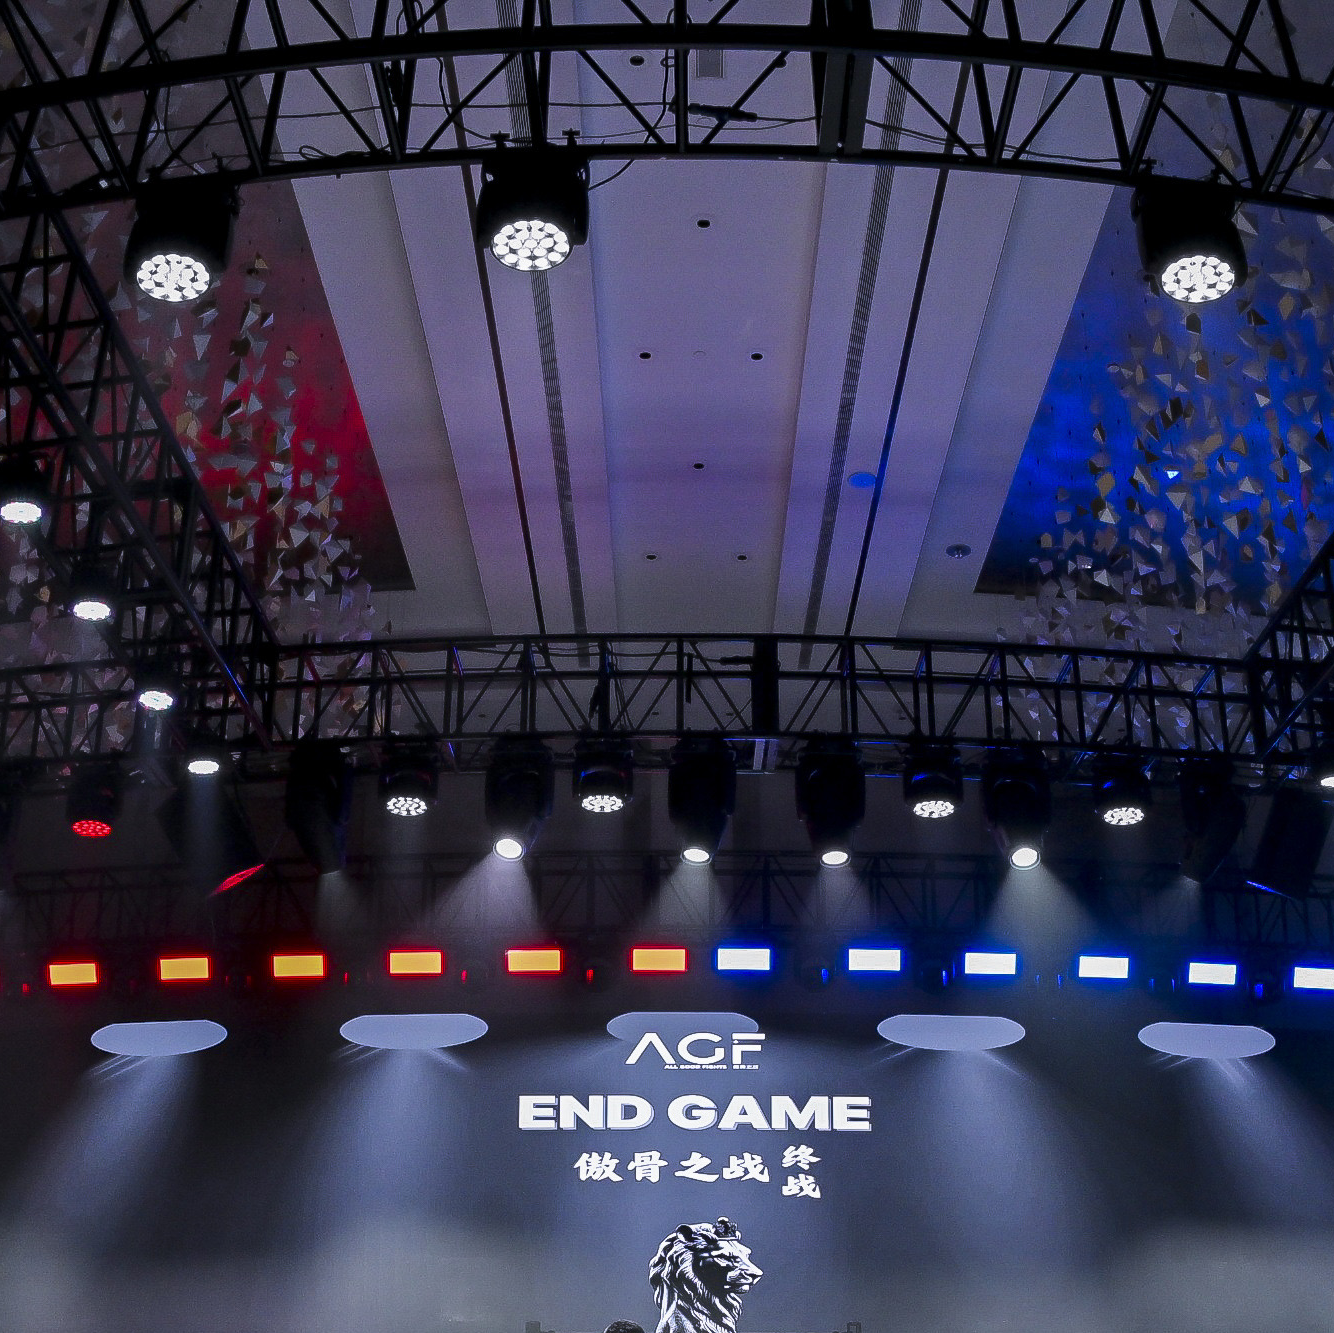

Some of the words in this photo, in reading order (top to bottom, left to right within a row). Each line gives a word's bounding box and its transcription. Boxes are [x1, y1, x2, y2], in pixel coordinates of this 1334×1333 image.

[624, 1032, 766, 1065] AGF
[517, 1094, 655, 1131] END
[666, 1094, 872, 1132] GAME
[573, 1150, 771, 1184] 傲骨之战
[780, 1144, 822, 1199] 终战
